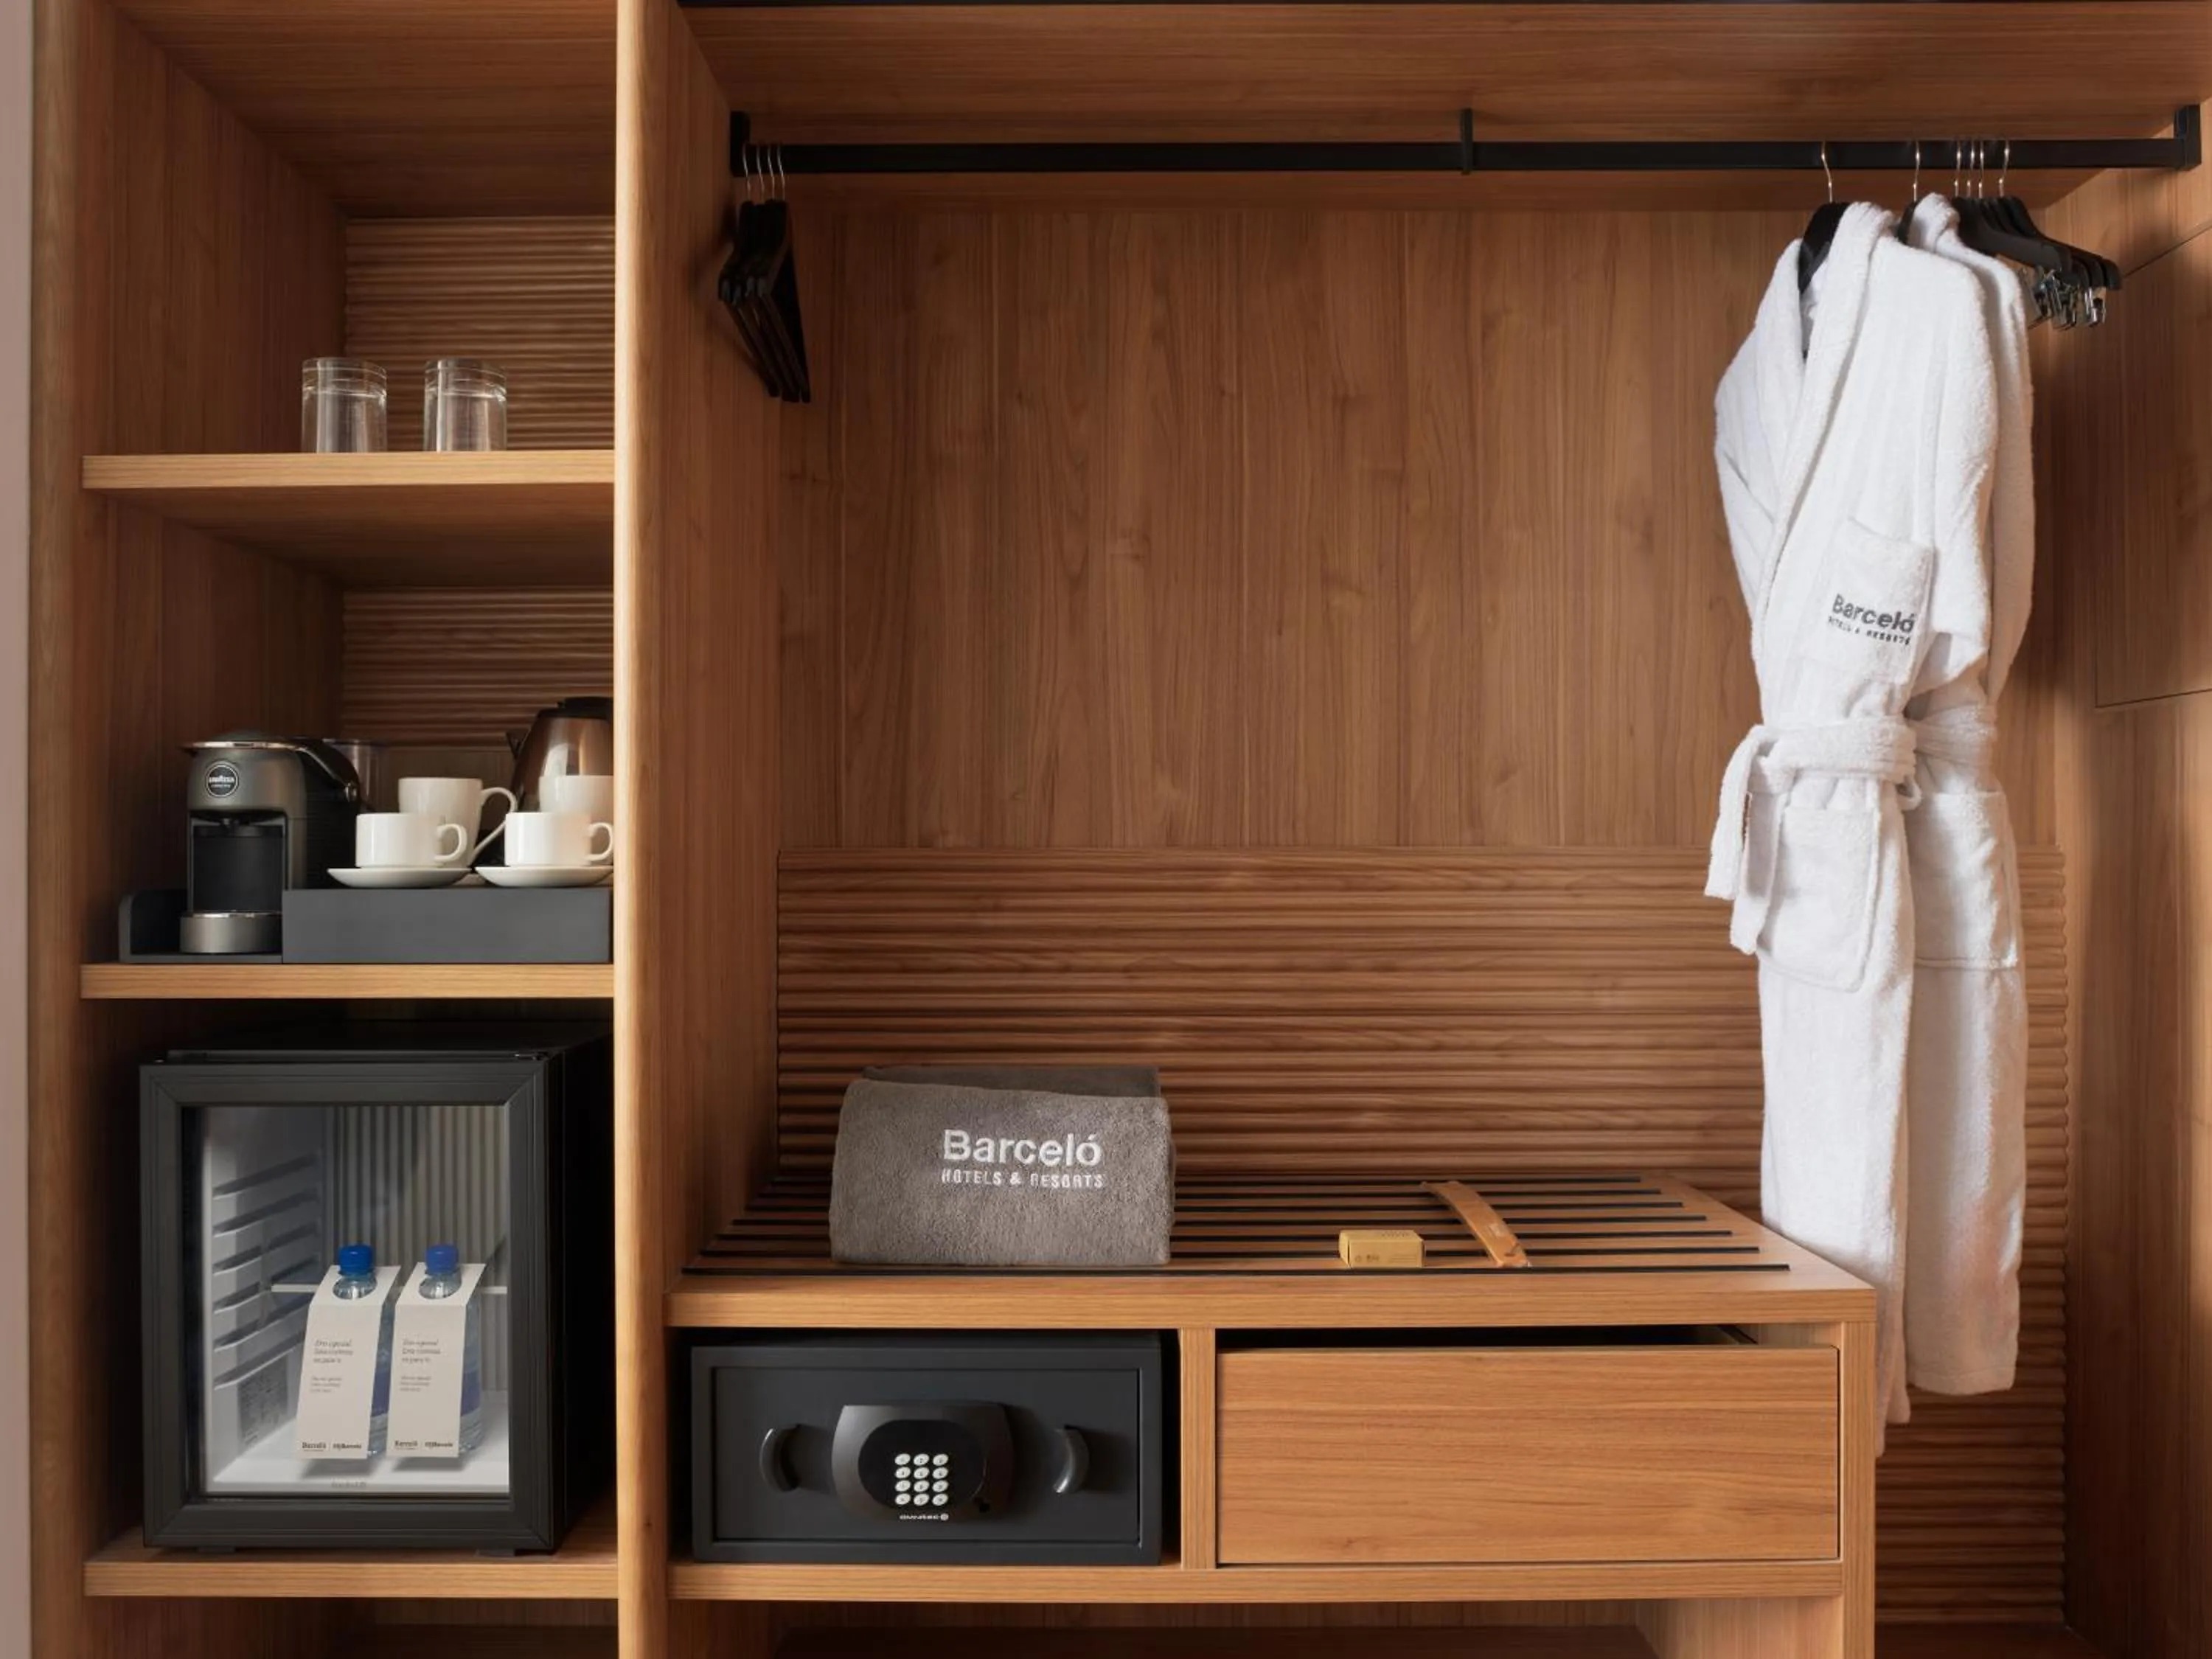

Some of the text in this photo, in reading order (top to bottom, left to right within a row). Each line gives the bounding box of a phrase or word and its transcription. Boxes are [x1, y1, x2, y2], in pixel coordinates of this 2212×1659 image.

[1832, 593, 1916, 633] Barceló
[943, 1129, 1103, 1166] Barceló
[941, 1168, 1104, 1189] HOTELS & RESORTS
